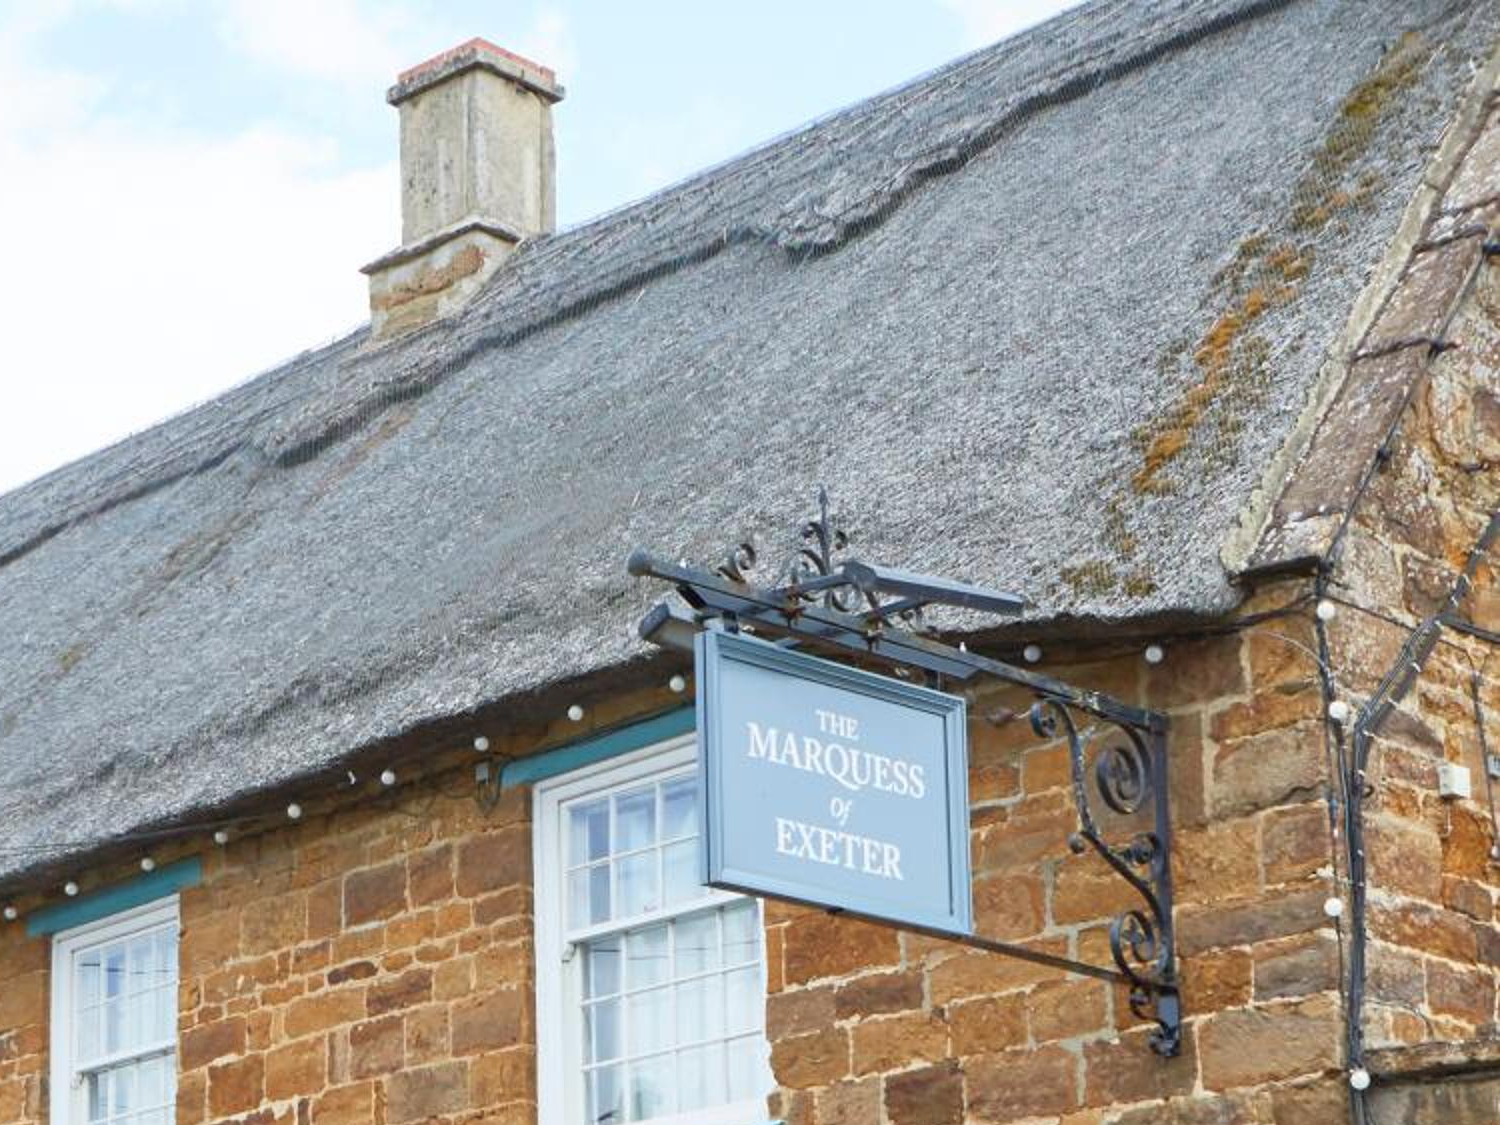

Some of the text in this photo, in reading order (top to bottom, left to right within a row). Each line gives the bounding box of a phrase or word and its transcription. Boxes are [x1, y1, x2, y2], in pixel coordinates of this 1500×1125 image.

[816, 709, 859, 740] THE
[746, 722, 925, 799] MARQUESS
[830, 797, 852, 826] of
[775, 817, 903, 880] EXETER
